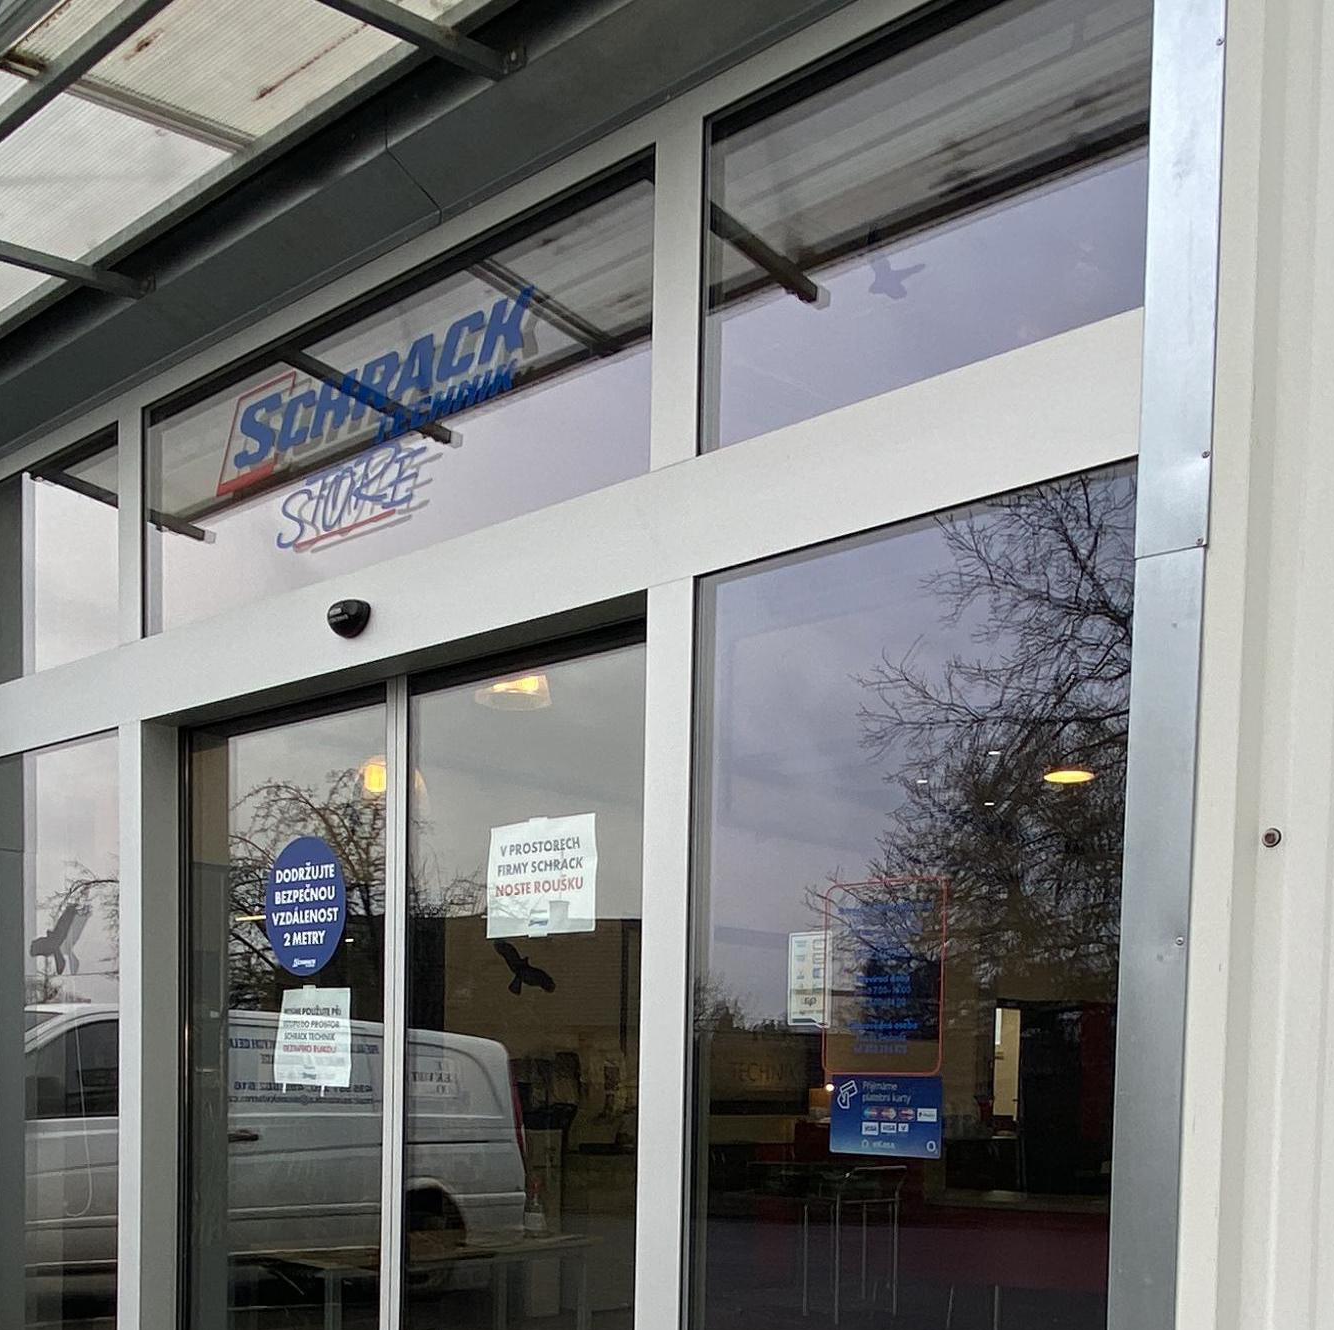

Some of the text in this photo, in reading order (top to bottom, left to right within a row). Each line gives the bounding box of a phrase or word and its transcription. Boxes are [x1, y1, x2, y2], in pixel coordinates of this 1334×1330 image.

[234, 285, 535, 470] SCHRACK
[375, 360, 516, 446] TECHNIK
[276, 443, 427, 549] STORE
[500, 836, 581, 857] V PROSTORECH
[275, 861, 335, 883] DODRŽUJTE
[497, 856, 584, 877] FIRMY SCHRACK
[274, 884, 335, 905] BEZPEČNOU
[495, 875, 584, 897] NOSTE ROUŠKU
[271, 906, 339, 926] VZDÁLENOST
[283, 930, 326, 947] 2 METRY
